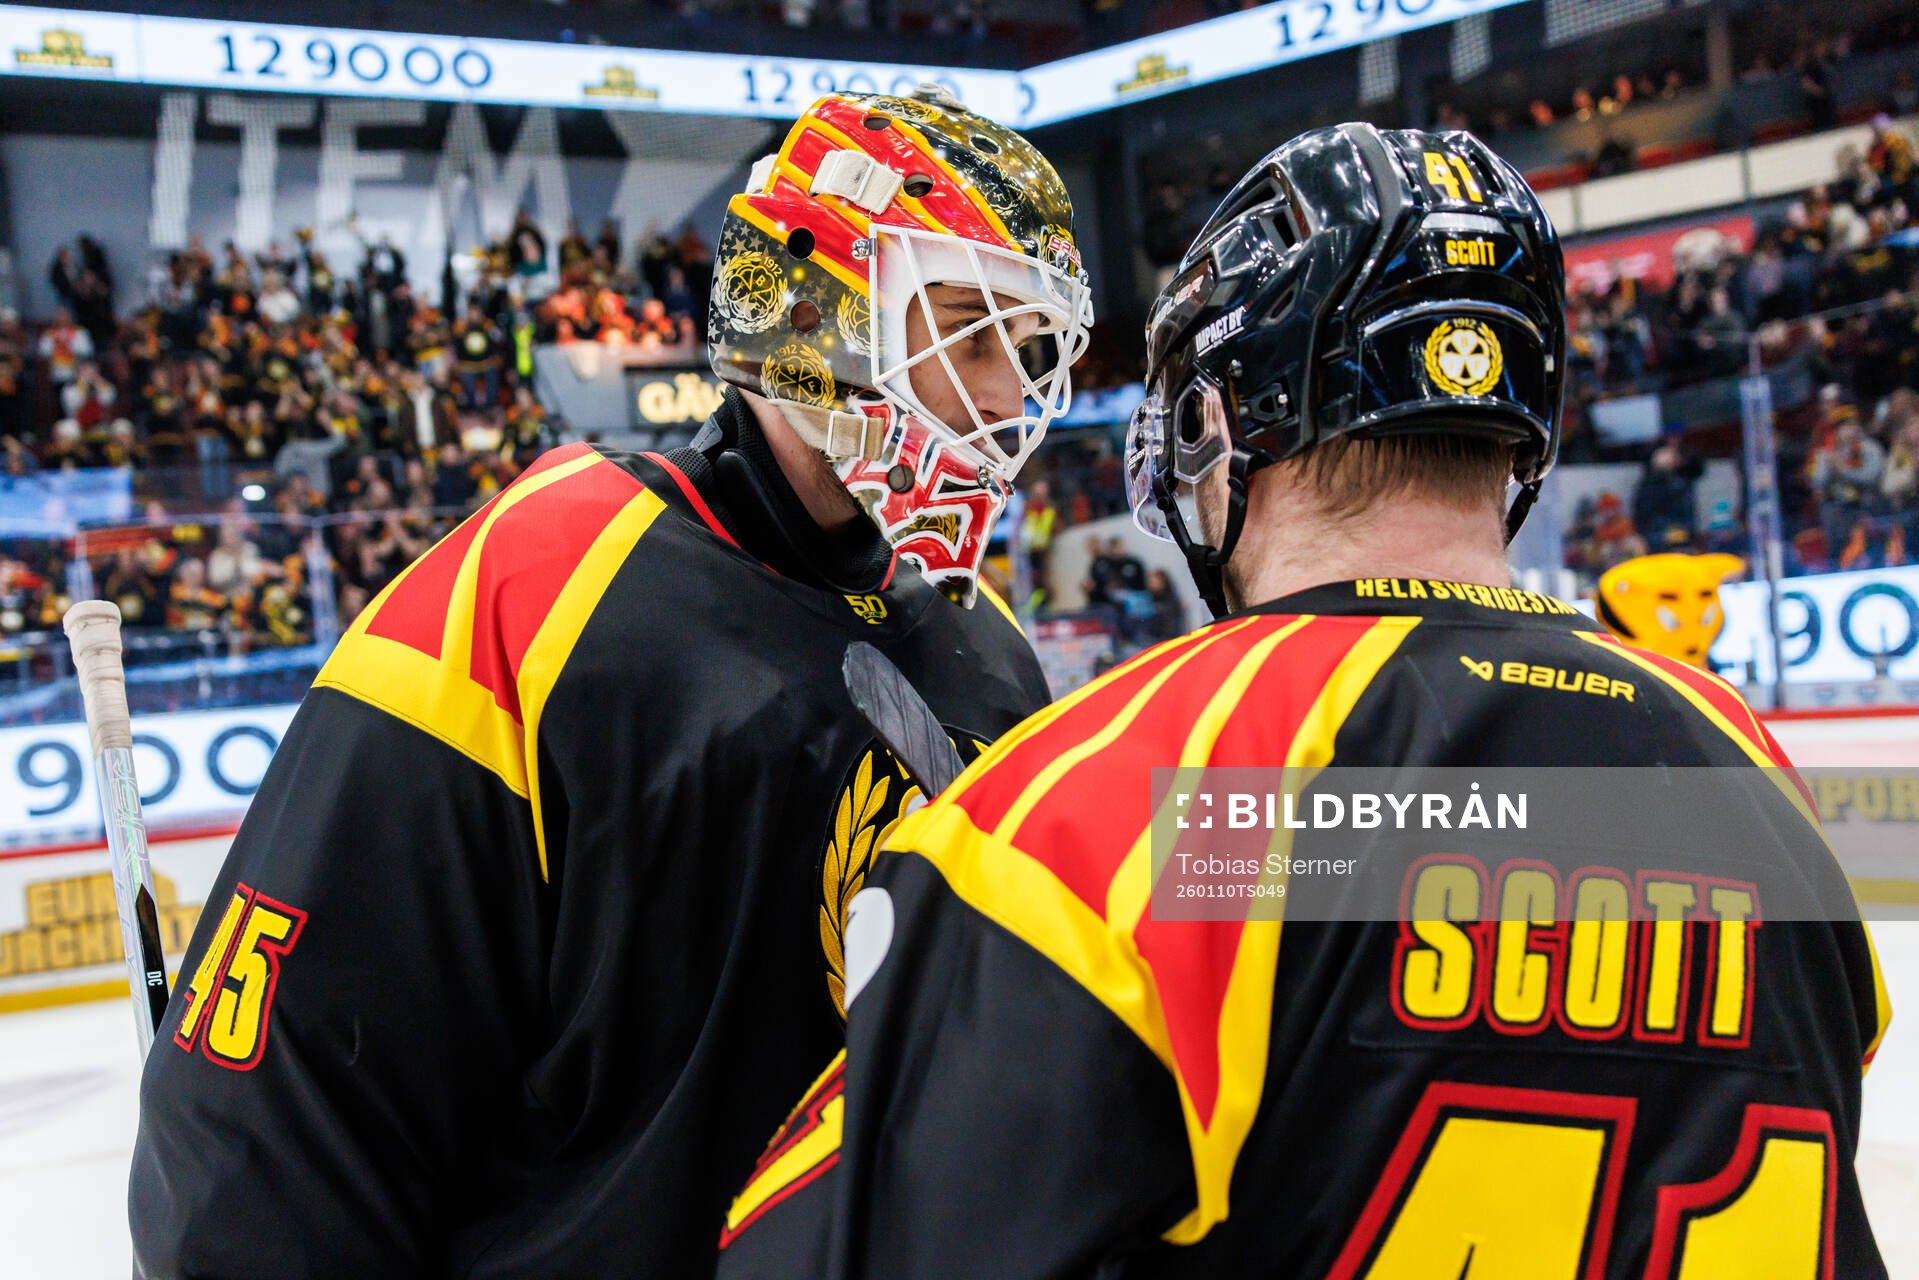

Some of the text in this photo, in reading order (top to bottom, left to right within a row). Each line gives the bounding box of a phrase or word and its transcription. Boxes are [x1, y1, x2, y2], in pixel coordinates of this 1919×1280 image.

[1422, 151, 1484, 203] 41
[763, 256, 784, 278] 1912
[1445, 239, 1496, 266] SCOTT
[1195, 315, 1230, 353] IMPACT
[1228, 305, 1247, 332] BY
[775, 344, 797, 357] 1912
[842, 593, 888, 625] 50
[1355, 578, 1429, 600] HELA
[1427, 579, 1546, 614] SVERIGES
[1500, 661, 1637, 703] BAUER
[1390, 852, 1763, 1049] SCOTT
[147, 970, 163, 987] DC
[173, 881, 310, 1072] 45
